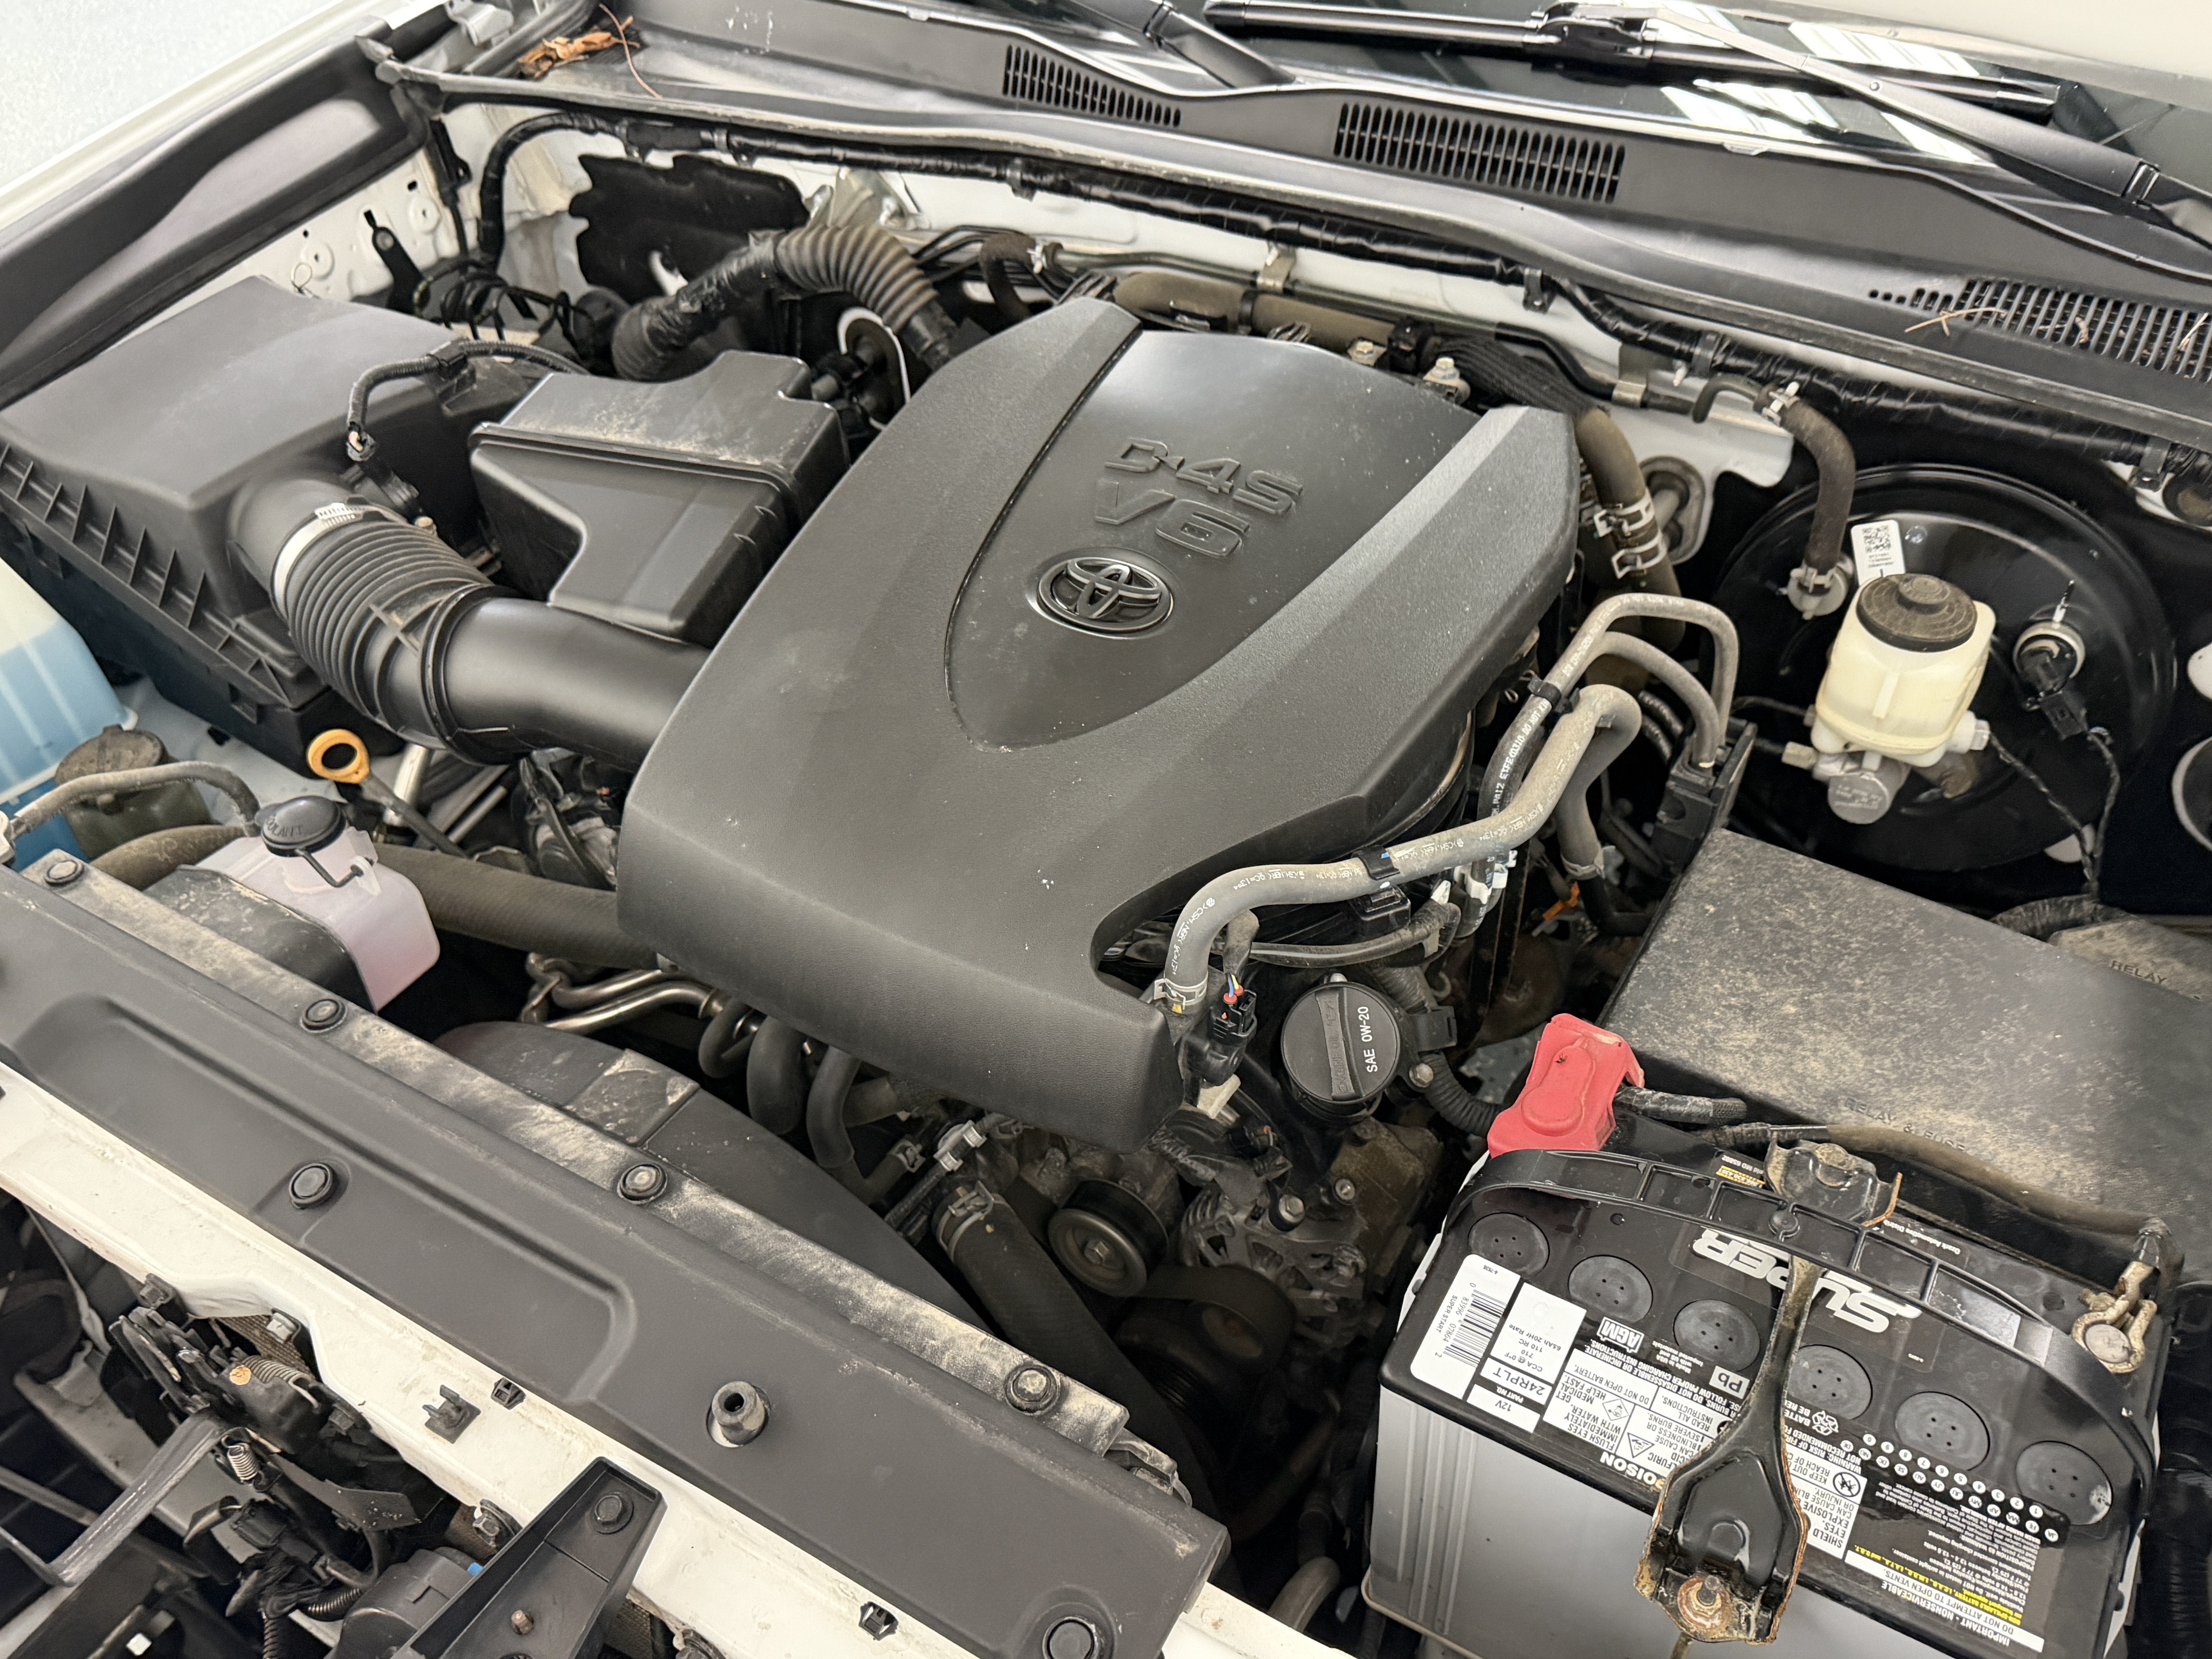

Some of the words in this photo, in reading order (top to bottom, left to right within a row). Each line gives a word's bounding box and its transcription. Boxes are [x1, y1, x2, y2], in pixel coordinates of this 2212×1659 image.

[1094, 477, 1249, 557] V6
[2110, 960, 2167, 984] RELAY
[1357, 1006, 1373, 1042] 0W-20
[1364, 1048, 1378, 1072] SAE
[1882, 1219, 1905, 1232] Distrib
[1443, 1294, 1458, 1315] SUPER
[1455, 1296, 1469, 1316] 83996
[1434, 1313, 1449, 1333] START
[1508, 1323, 1525, 1335] Rate
[1442, 1322, 1456, 1342] 07864
[1525, 1331, 1543, 1343] 20Hr
[1601, 1320, 1640, 1349] AGM
[1518, 1338, 1530, 1346] RC
[1530, 1343, 1544, 1353] 110
[1543, 1339, 1561, 1351] 65Ah
[1520, 1348, 1534, 1358] 710
[1582, 1344, 1623, 1367] INCINERATE.
[1588, 1338, 1638, 1366] INSTRUCTIONS.
[1655, 1353, 1669, 1364] USA
[1659, 1349, 1670, 1358] and
[1670, 1354, 1680, 1362] US
[1516, 1355, 1526, 1364] @
[1526, 1360, 1543, 1372] CCA
[1679, 1358, 1692, 1367] with
[1572, 1364, 1604, 1384] BATTERY.
[1622, 1362, 1633, 1372] OR
[1637, 1360, 1672, 1381] CHARGING
[1674, 1362, 1692, 1374] Made
[1492, 1365, 1545, 1396] 24RPLT
[1562, 1374, 1585, 1390] FAST.
[1604, 1379, 1623, 1393] OPEN
[1632, 1366, 1678, 1392] DISASSEMBLE
[1671, 1375, 1699, 1393] PROPER
[1716, 1371, 1743, 1393] Pb
[1494, 1385, 1508, 1396] NO.
[1506, 1391, 1524, 1403] PART
[1555, 1389, 1572, 1403] GET
[1558, 1382, 1594, 1404] MEDICAL
[1585, 1385, 1606, 1401] HELP
[1623, 1388, 1638, 1400] NOT
[1678, 1387, 1693, 1399] NOT
[1699, 1387, 1727, 1405] FOLLOW
[1494, 1398, 1513, 1412] 12V
[1638, 1394, 1649, 1405] DO
[1692, 1393, 1704, 1404] DO
[1660, 1395, 1713, 1424] INSTRUCTIONS.
[1703, 1398, 1729, 1415] BURNS.
[1727, 1400, 1741, 1412] SE.
[1798, 1405, 1810, 1417] BE
[1568, 1404, 1599, 1424] WATER.
[1645, 1412, 1673, 1429] BURNS.
[1676, 1411, 1690, 1422] ALL
[1564, 1412, 1618, 1443] IMMEDIATELY
[1567, 1423, 1588, 1438] EYES
[1600, 1419, 1621, 1434] WITH
[1646, 1421, 1657, 1431] OR
[1691, 1418, 1710, 1431] READ
[1657, 1426, 1697, 1449] BLINDNESS
[1673, 1424, 1700, 1441] SEVERE
[1589, 1433, 1614, 1451] FLUSH
[1654, 1434, 1678, 1450] CAUSE
[1792, 1429, 1846, 1458] RECOMMENDED
[1798, 1440, 1808, 1450] OF
[1670, 1451, 1688, 1465] CID
[1679, 1445, 1694, 1457] CAN
[1808, 1444, 1826, 1458] RISK
[1647, 1451, 1677, 1471] LFURIC
[1794, 1455, 1805, 1465] OF
[1826, 1452, 1862, 1474] WARNING:
[1846, 1452, 1862, 1465] NOT
[1793, 1463, 1808, 1475] OUT
[1805, 1460, 1830, 1477] REACH
[1895, 1465, 1905, 1473] SE
[1809, 1470, 1827, 1484] KEEP
[1810, 1494, 1835, 1511] CAUSE
[1813, 1487, 1842, 1505] INJURY.
[1836, 1506, 1852, 1519] CAN
[1843, 1501, 1854, 1511] OR
[1989, 1506, 1998, 1514] AP
[1802, 1501, 1849, 1528] EXPLOSIVE
[1820, 1520, 1846, 1538] EYES.
[2028, 1522, 2036, 1530] FE
[1812, 1527, 1843, 1548] SHIELD
[2047, 1530, 2056, 1539] JA
[1882, 1568, 1910, 1587] VENTS.
[1911, 1582, 1932, 1597] OPEN
[1881, 1580, 1954, 1620] NONSERVICEABLE
[1934, 1592, 1945, 1603] TO
[1946, 1598, 1982, 1620] ATTEMPT
[1983, 1615, 2000, 1628] NOT
[1960, 1616, 2010, 1646] IMPORTANT
[2002, 1623, 2013, 1635] DO
